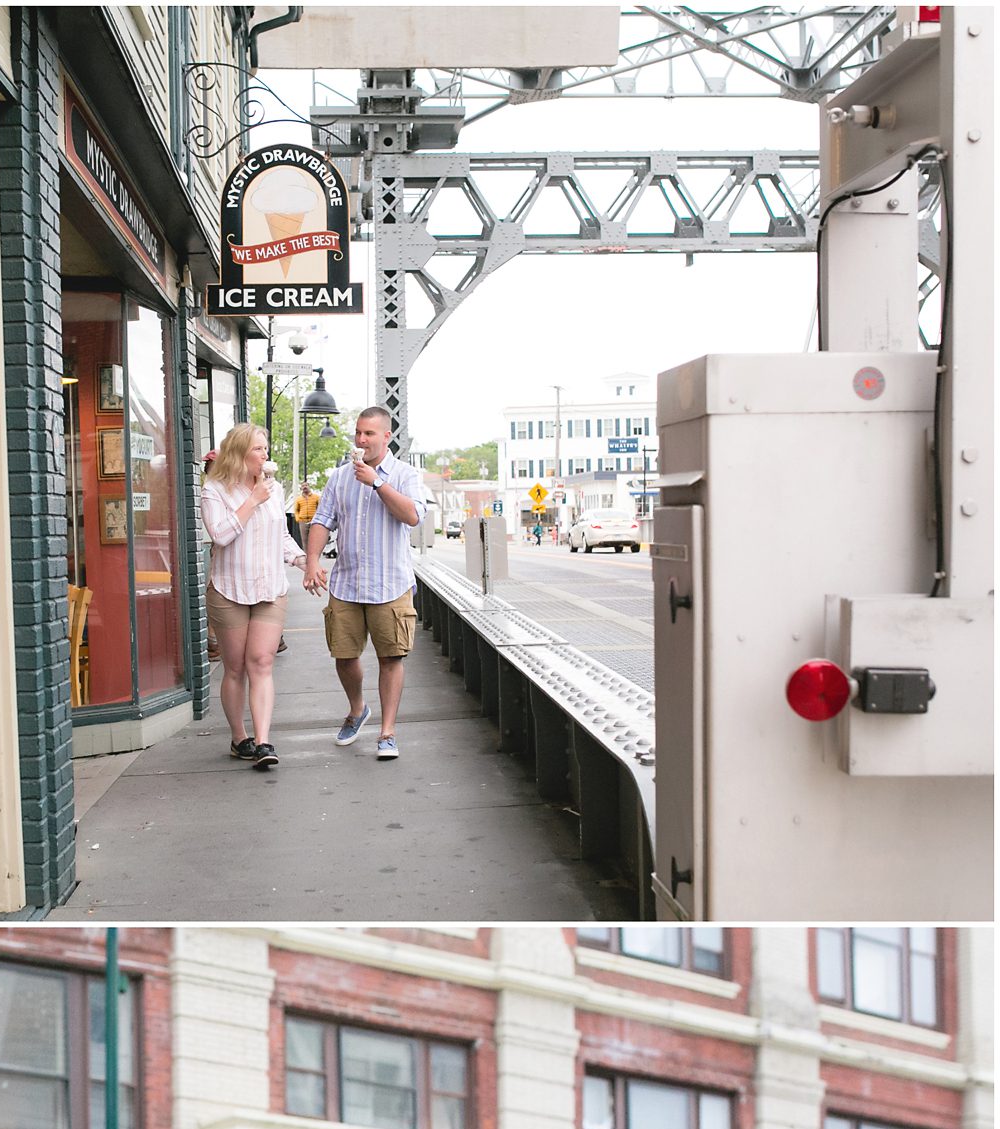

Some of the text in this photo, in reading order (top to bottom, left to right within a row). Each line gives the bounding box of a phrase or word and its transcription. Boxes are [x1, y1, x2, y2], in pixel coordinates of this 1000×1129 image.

[86, 130, 159, 263] MYSTIC DRAWBRIDGE
[226, 149, 343, 208] MYSTIC DRAWBRIDGE
[255, 242, 288, 260] MAKE
[289, 236, 310, 251] THE
[218, 287, 353, 308] ICE CREAM
